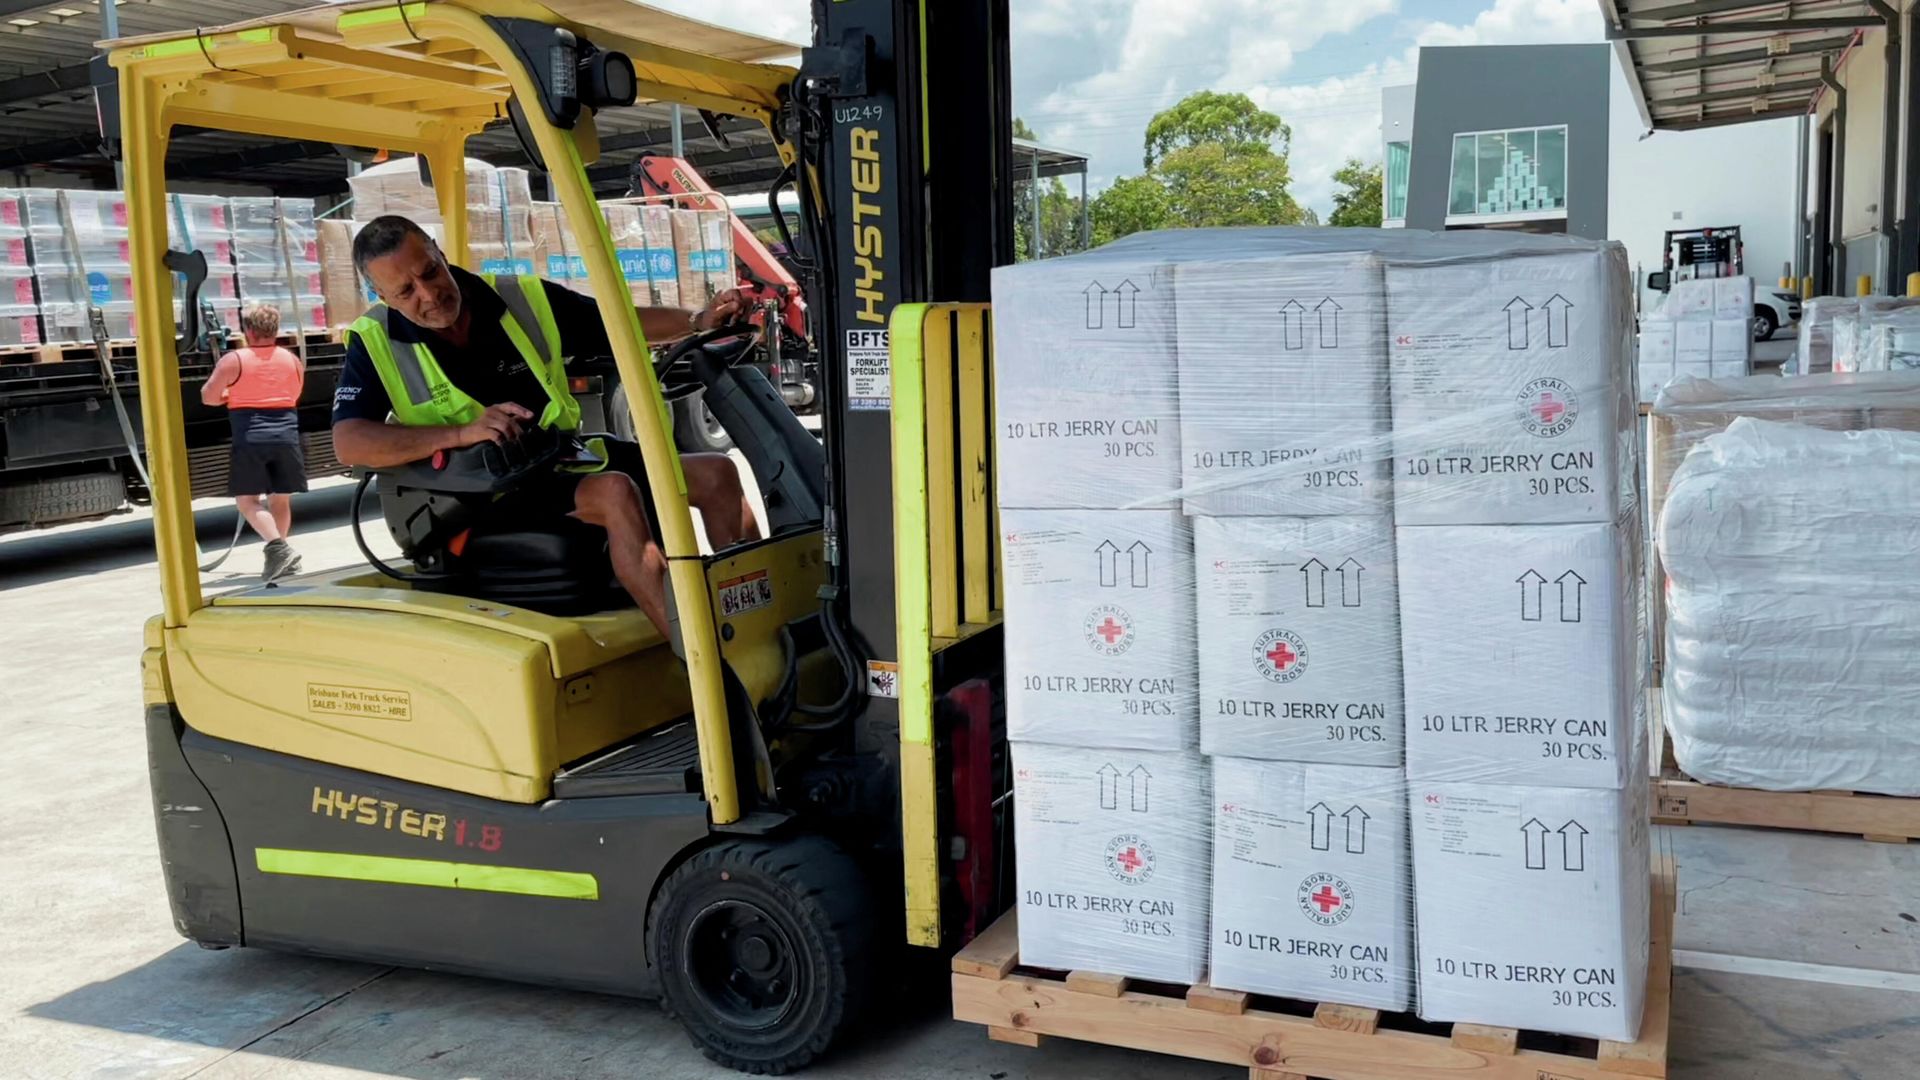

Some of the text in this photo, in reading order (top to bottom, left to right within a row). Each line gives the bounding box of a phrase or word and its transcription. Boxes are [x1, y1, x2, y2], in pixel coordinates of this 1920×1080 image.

[850, 126, 885, 324] HYSTER
[622, 253, 658, 273] unicf
[848, 331, 889, 347] BFTS
[855, 358, 888, 367] FORKLIFT
[1008, 419, 1158, 439] 10 LTR JERRY CAN
[1540, 410, 1576, 436] CROSS
[1104, 441, 1159, 457] 30 PCS.
[1193, 451, 1213, 469] 10
[1220, 451, 1255, 467] LTR
[1407, 451, 1593, 476] 10 LTR JERRY CAN
[1303, 470, 1363, 488] 30 PCS.
[1529, 476, 1594, 496] 30 PCS.
[1255, 631, 1306, 657] AUSTRALIAN
[1255, 656, 1306, 681] RED CROSS
[1024, 675, 1174, 694] 10 LTR JERRY CAN
[312, 699, 337, 709] SALES
[388, 706, 407, 717] HIRE
[360, 692, 380, 702] Truck
[382, 695, 408, 705] Service
[1122, 700, 1176, 716] 30 PCS.
[1218, 699, 1385, 720] 10 LTR JERRY CAN
[1326, 725, 1386, 742] 30 PCS.
[1422, 714, 1607, 737] 10 LTR JERRY CAN
[1542, 741, 1607, 760] 30 PCS.
[312, 786, 502, 852] HYSTER 1.8
[1300, 874, 1352, 900] CROSS RED
[1026, 890, 1174, 916] 10 LTR JERRY CAN
[1300, 896, 1352, 924] AUSTRALIAN
[1122, 918, 1175, 937] 30 PCS.
[1224, 929, 1388, 962] 10 LTR JERRY CAN
[1330, 964, 1388, 984] 30 PCS.
[1436, 957, 1616, 985] 10 LTR JERRY CAN
[1552, 990, 1617, 1008] 30 PCS.
